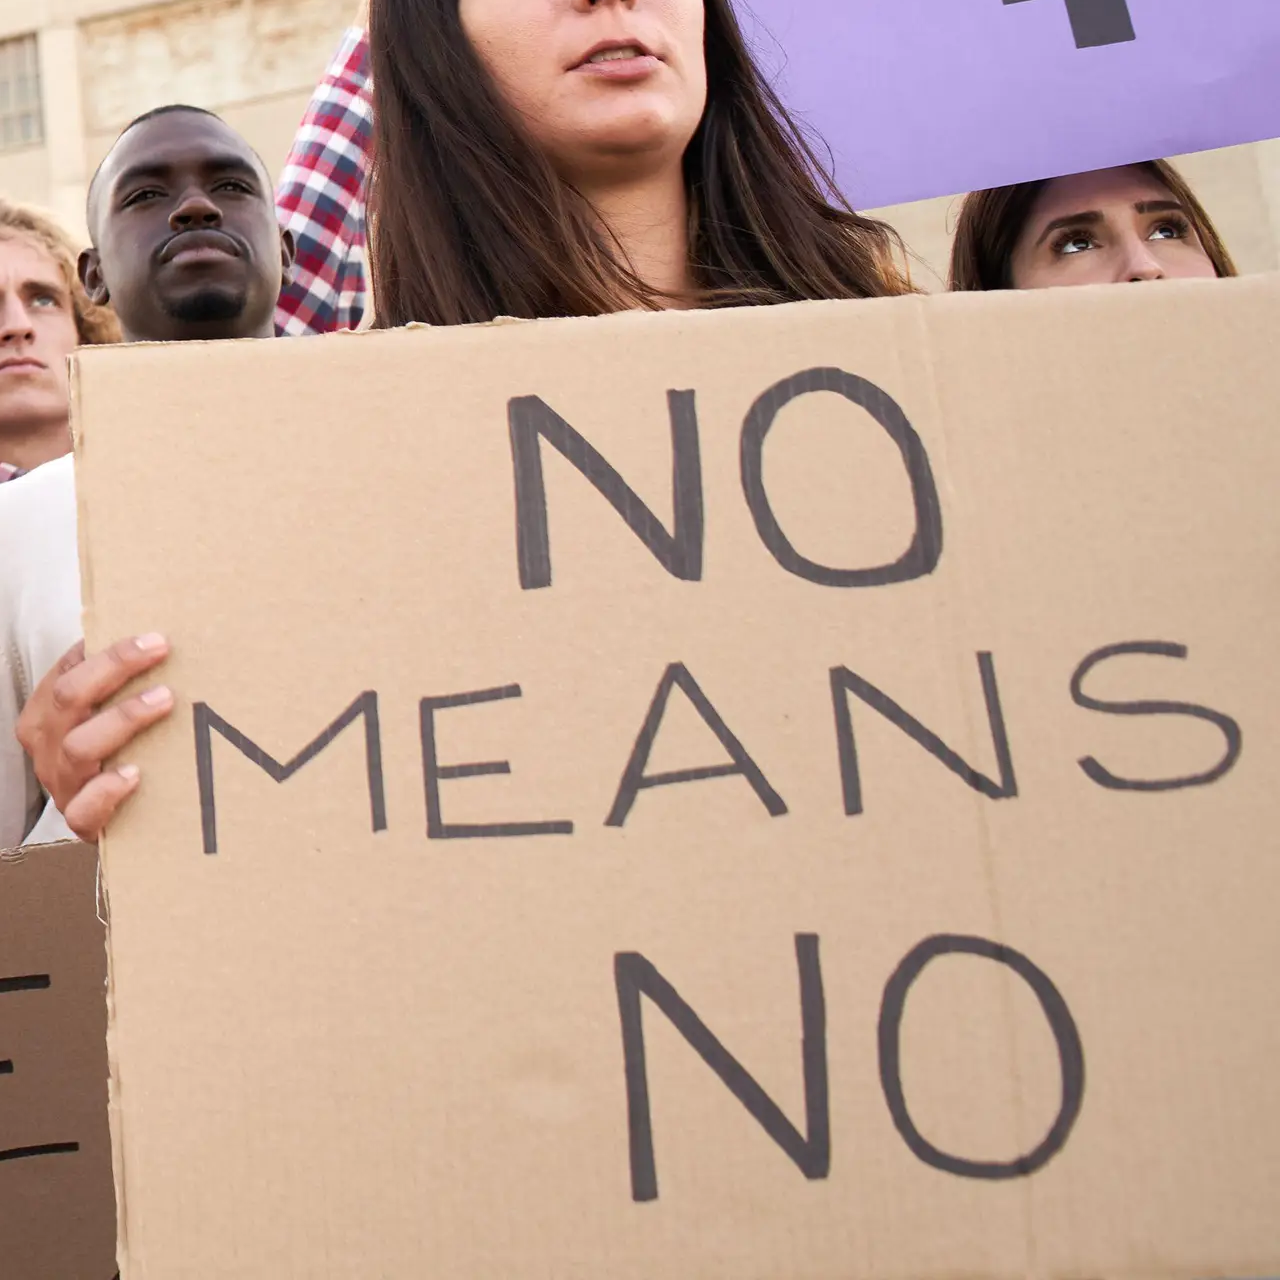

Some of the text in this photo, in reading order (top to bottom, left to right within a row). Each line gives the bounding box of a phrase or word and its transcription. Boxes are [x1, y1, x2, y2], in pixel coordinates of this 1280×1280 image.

[508, 367, 944, 589] NO
[193, 640, 1243, 855] MEANS
[614, 933, 1086, 1203] NO
